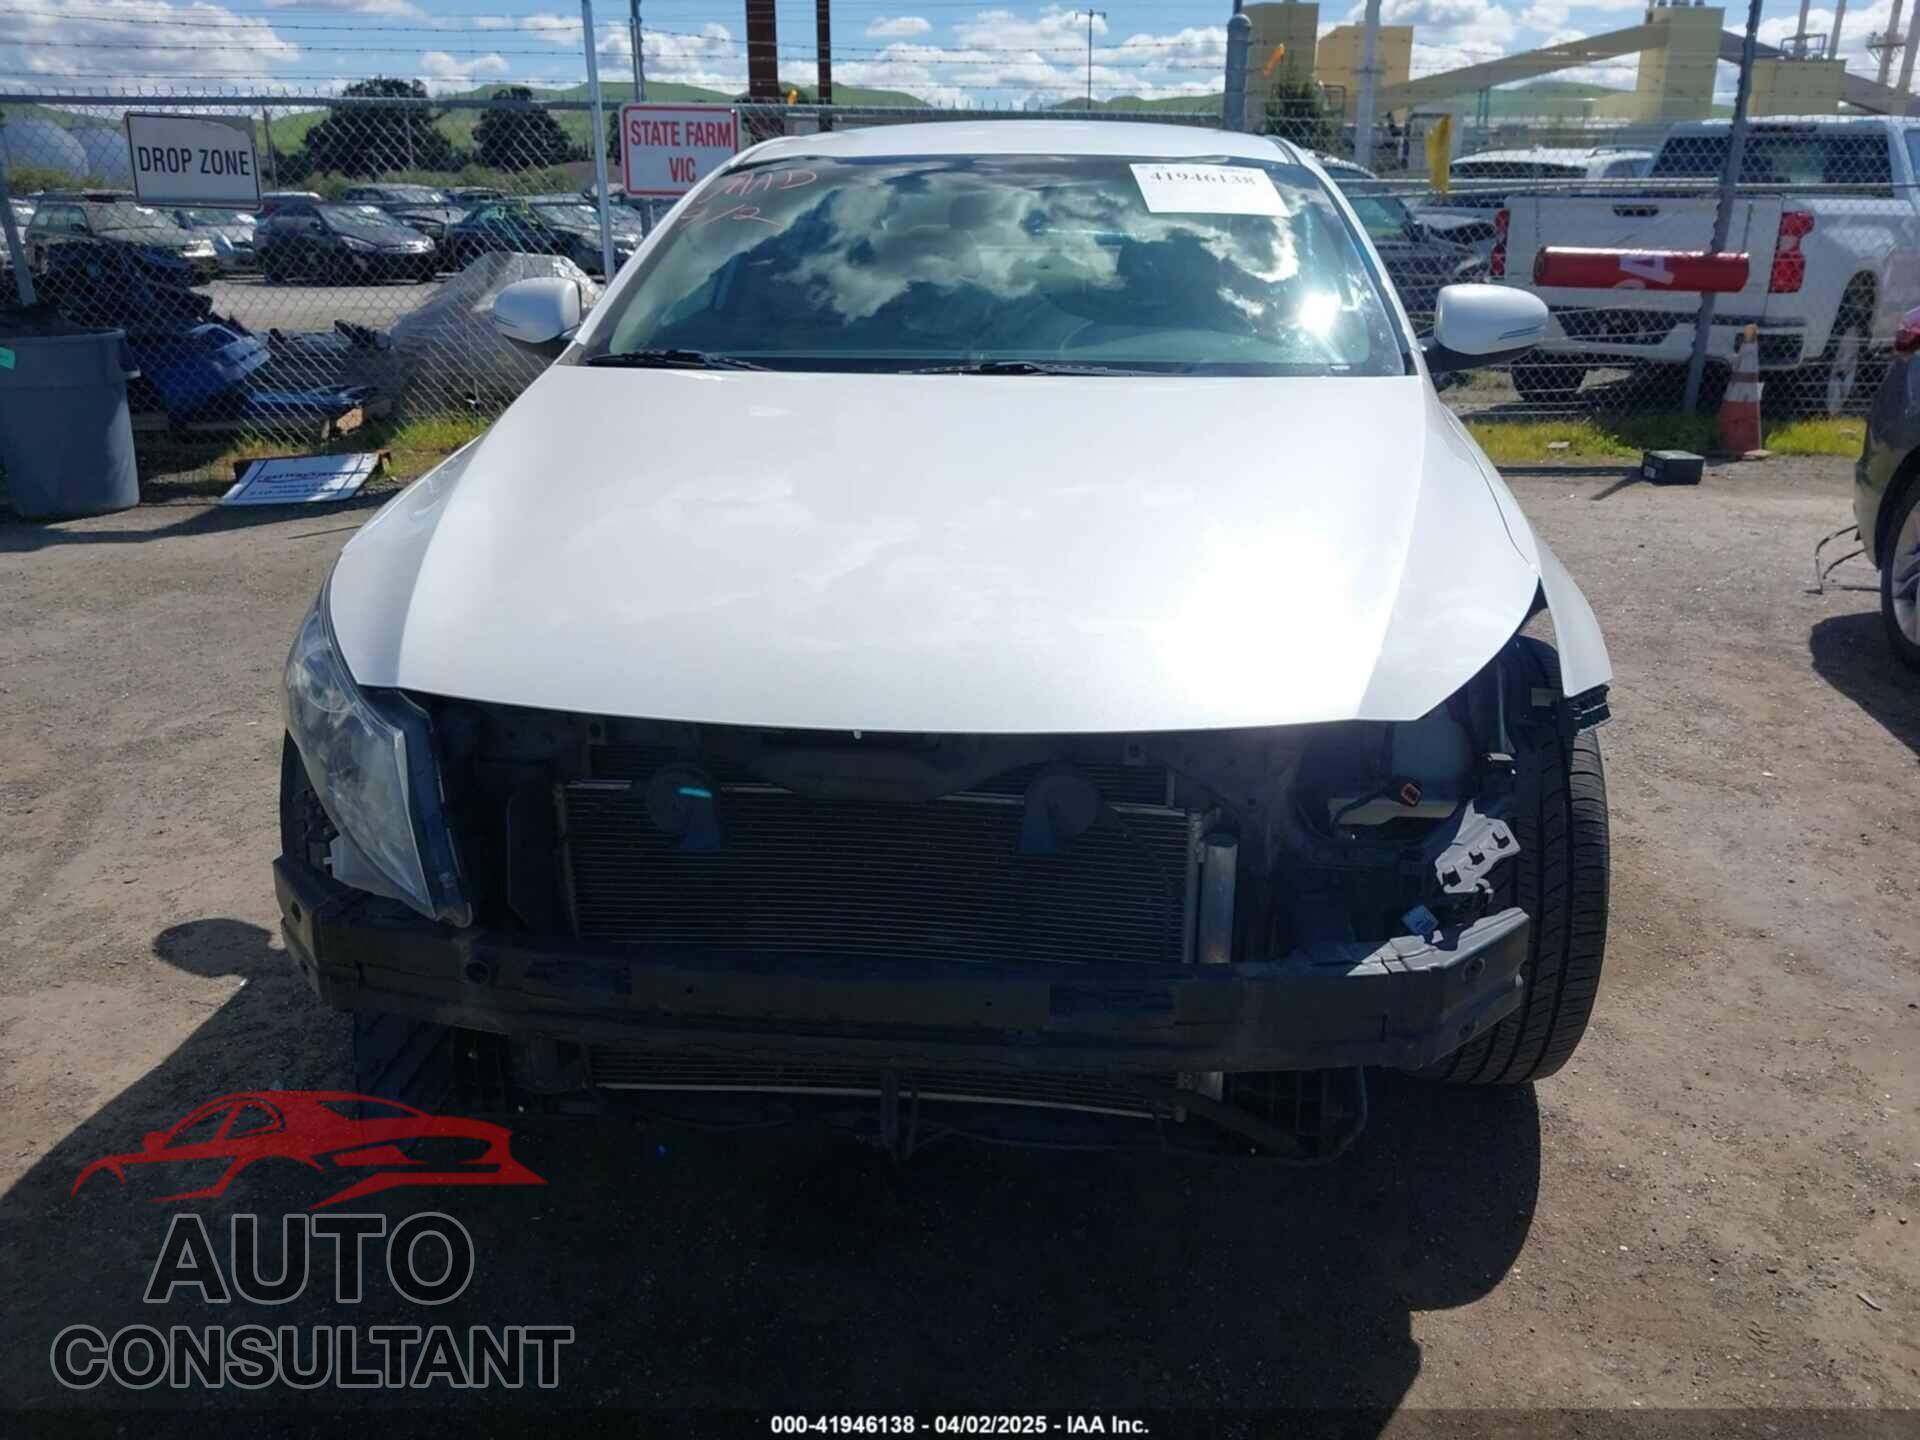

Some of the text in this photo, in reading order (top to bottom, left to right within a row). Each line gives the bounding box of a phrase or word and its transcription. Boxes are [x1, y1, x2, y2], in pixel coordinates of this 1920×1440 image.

[631, 119, 732, 147] STATE FARM
[138, 146, 251, 176] DROP ZONE
[668, 156, 697, 183] VIC
